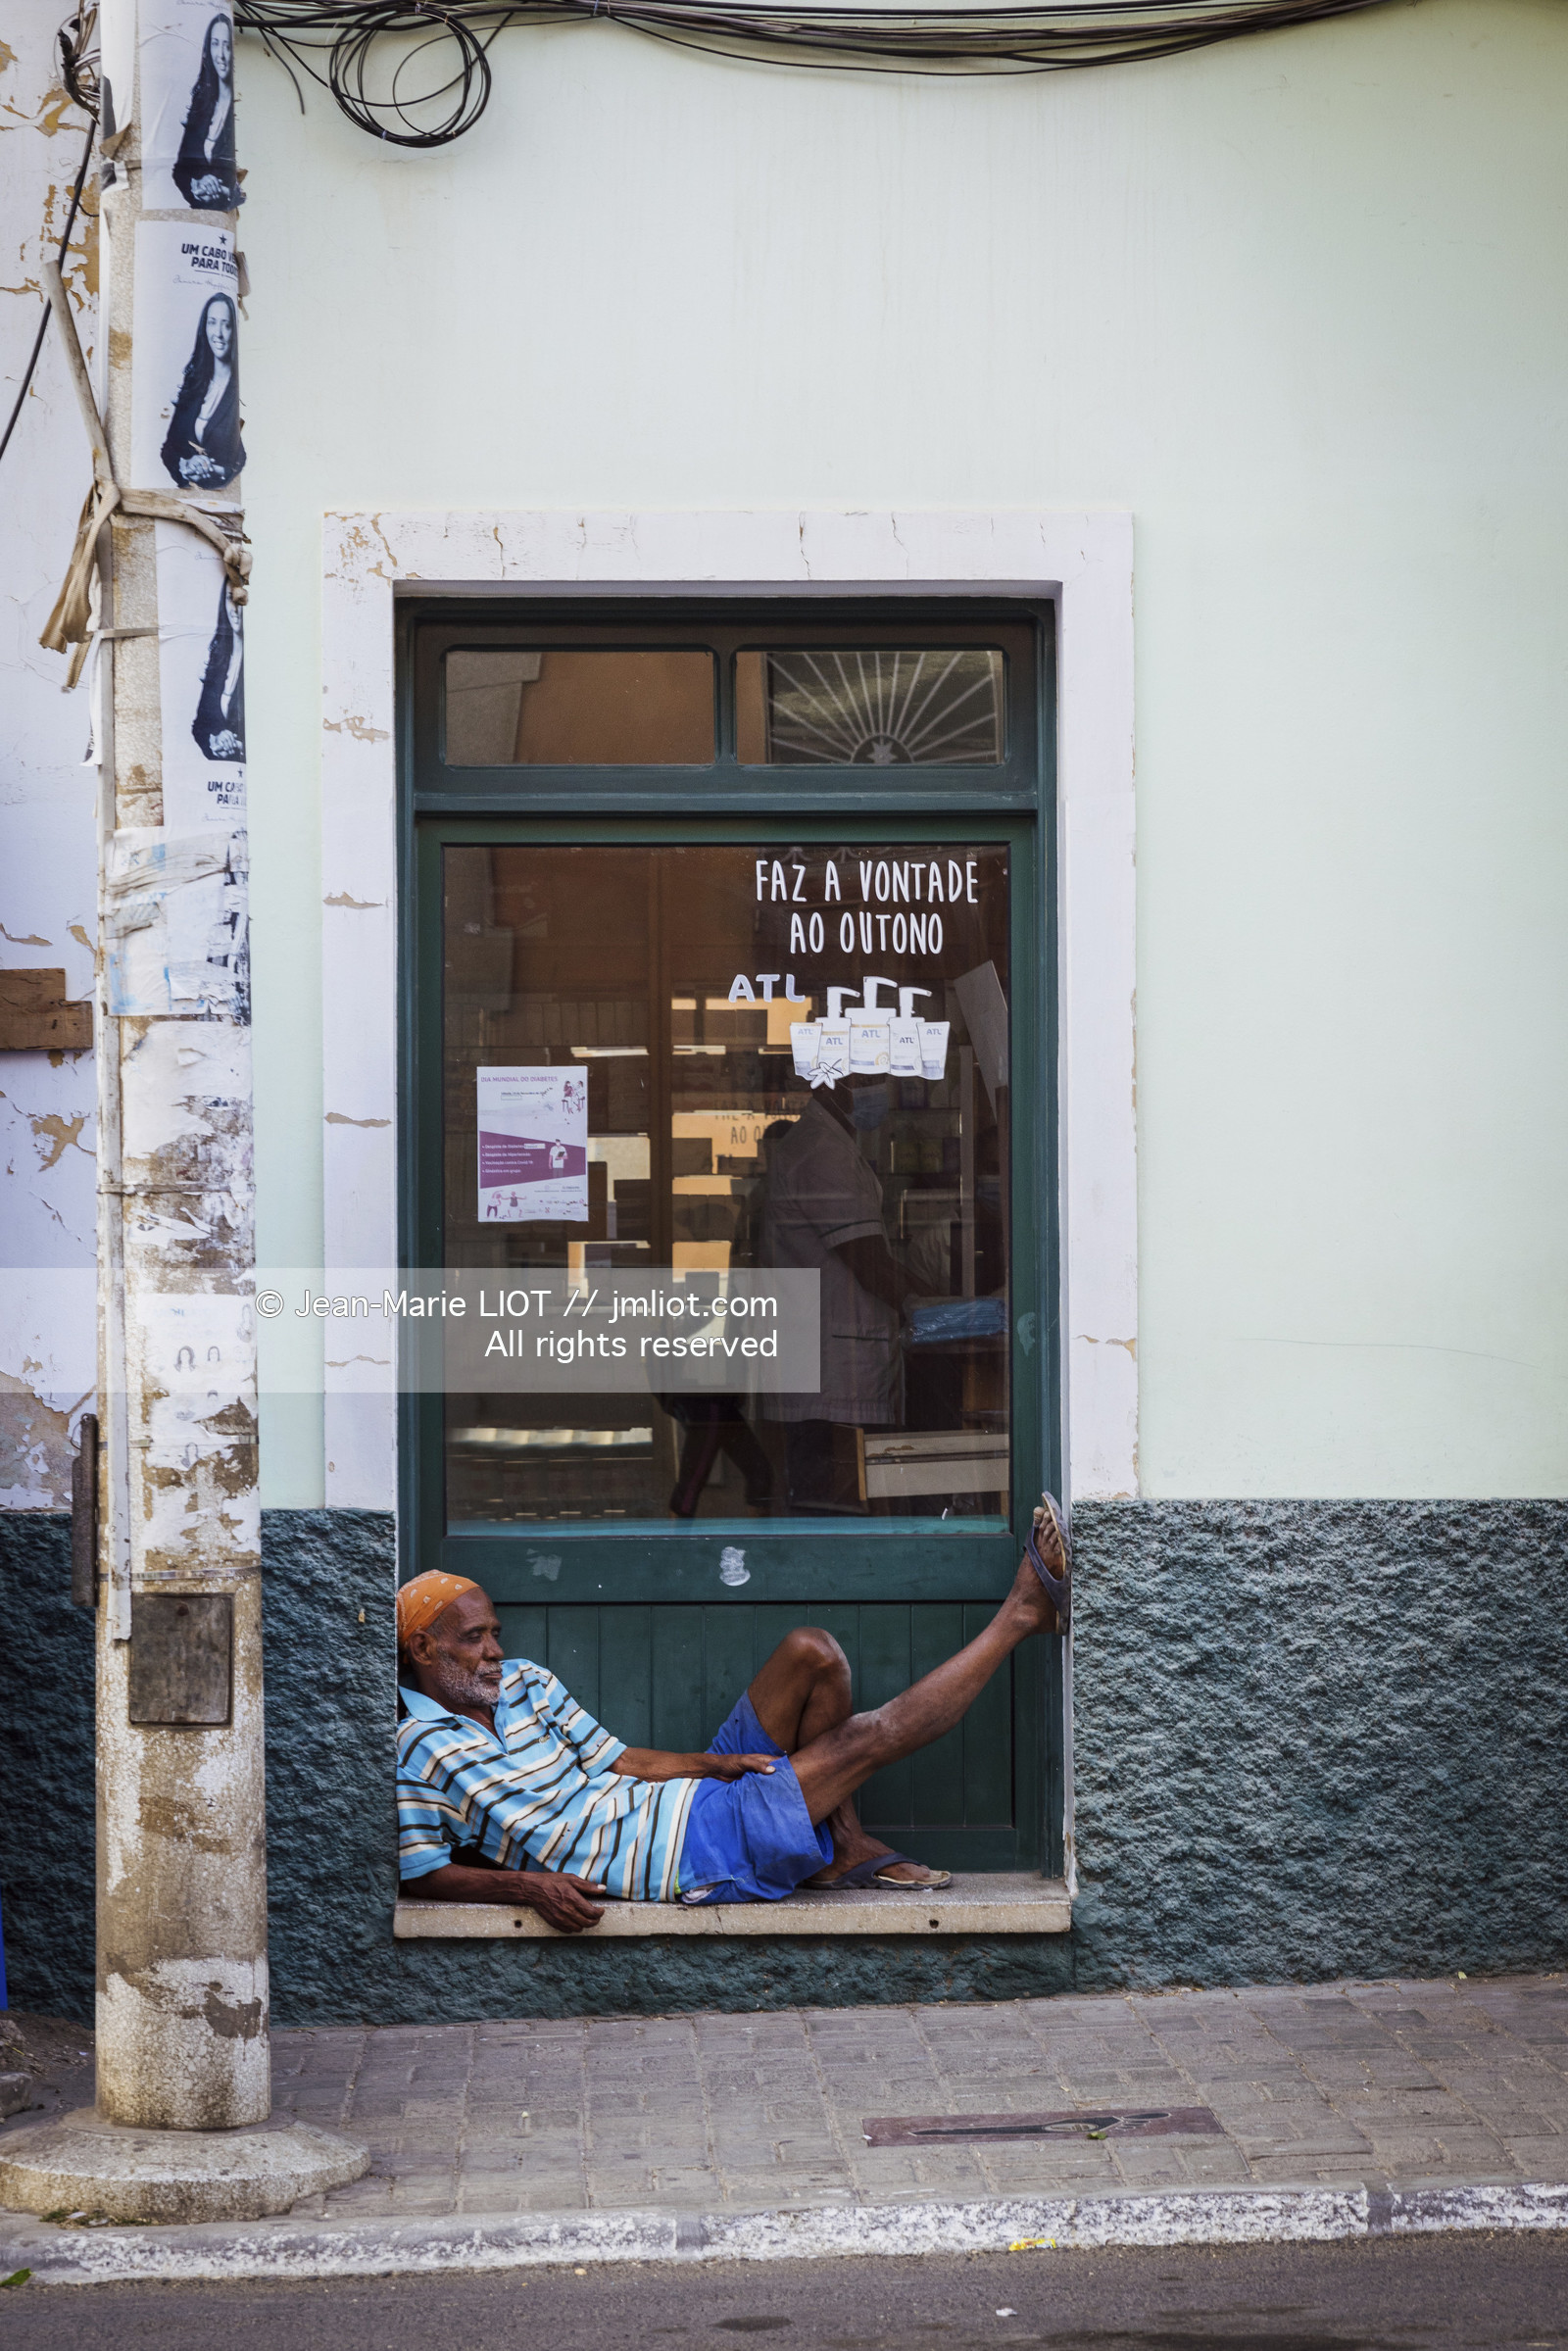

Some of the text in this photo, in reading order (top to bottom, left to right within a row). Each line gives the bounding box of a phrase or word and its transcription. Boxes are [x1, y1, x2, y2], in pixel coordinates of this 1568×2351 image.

[181, 243, 200, 255] UM
[202, 246, 226, 260] CABO
[191, 256, 219, 270] PARA
[208, 781, 223, 792] UM
[756, 859, 979, 904] FAZ A VONTADE
[789, 911, 944, 955] AO OUTONO
[728, 973, 807, 1004] ATL
[825, 1037, 843, 1046] ATL
[861, 1029, 881, 1039] ATL
